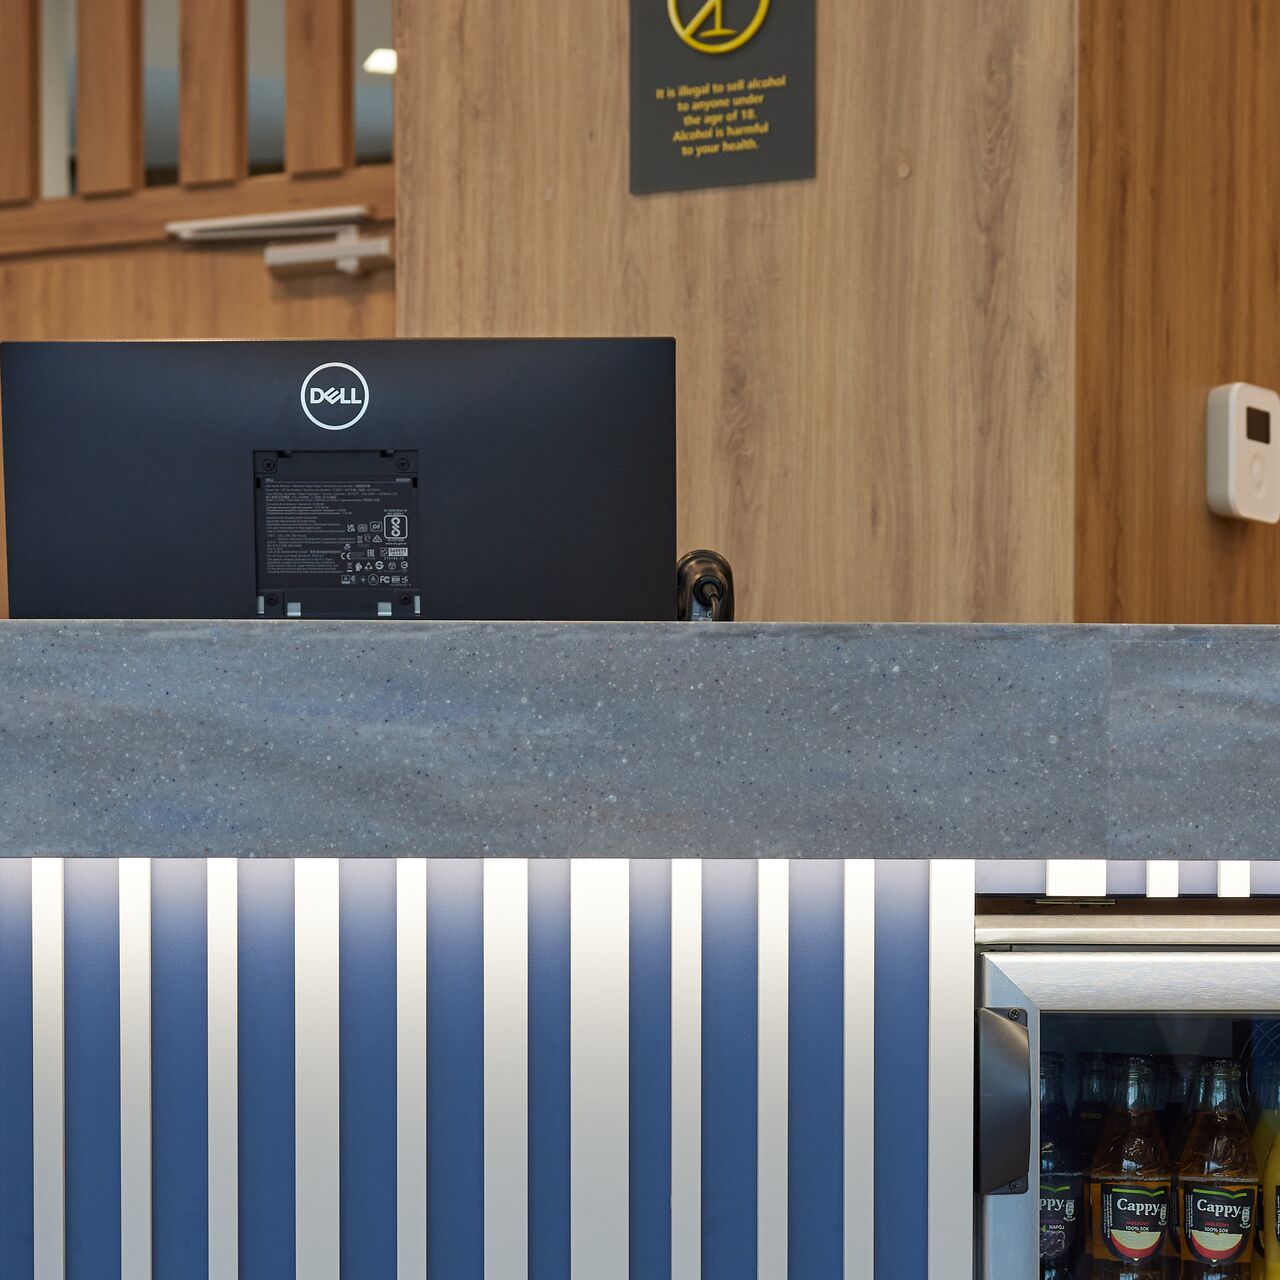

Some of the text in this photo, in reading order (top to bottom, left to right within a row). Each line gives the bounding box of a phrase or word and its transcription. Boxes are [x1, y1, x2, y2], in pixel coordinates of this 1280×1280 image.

[656, 75, 787, 100] It is illegal to sell alcohol
[677, 94, 765, 113] to anyone under
[683, 115, 702, 126] the
[703, 114, 724, 126] age
[725, 110, 738, 122] of
[672, 121, 770, 142] Alcohol is harmful
[681, 138, 759, 157] to your health.
[310, 387, 362, 405] DELL
[1039, 1198, 1065, 1211] ppy
[1116, 1198, 1160, 1216] Cappy
[1196, 1199, 1241, 1218] Cappy
